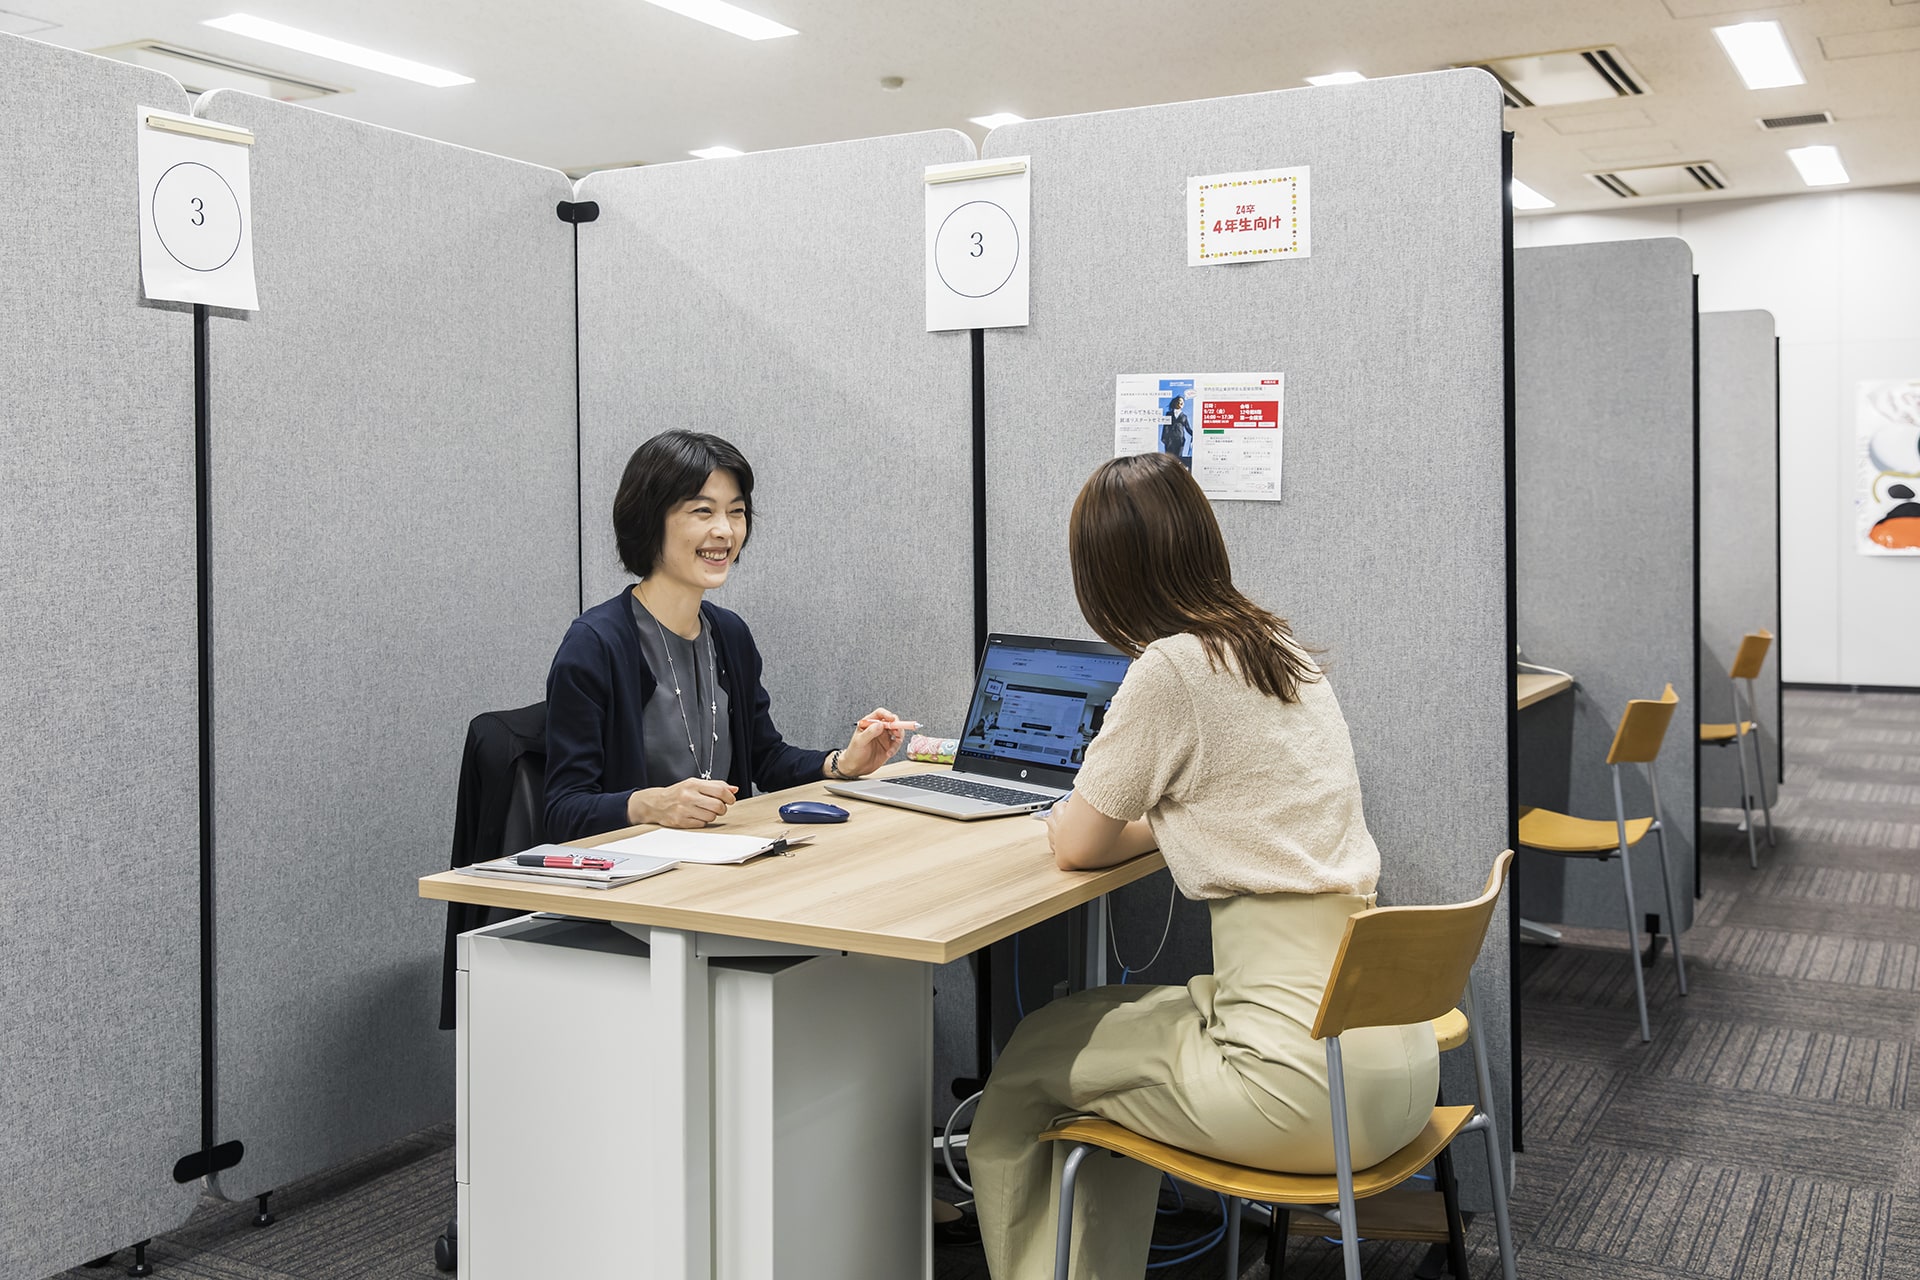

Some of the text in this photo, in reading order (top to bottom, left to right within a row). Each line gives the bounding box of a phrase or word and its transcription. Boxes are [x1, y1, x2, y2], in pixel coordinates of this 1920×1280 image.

[191, 197, 205, 226] 3
[1236, 204, 1256, 215] 24卒
[1213, 215, 1282, 234] 4年生向け
[970, 231, 984, 258] 3
